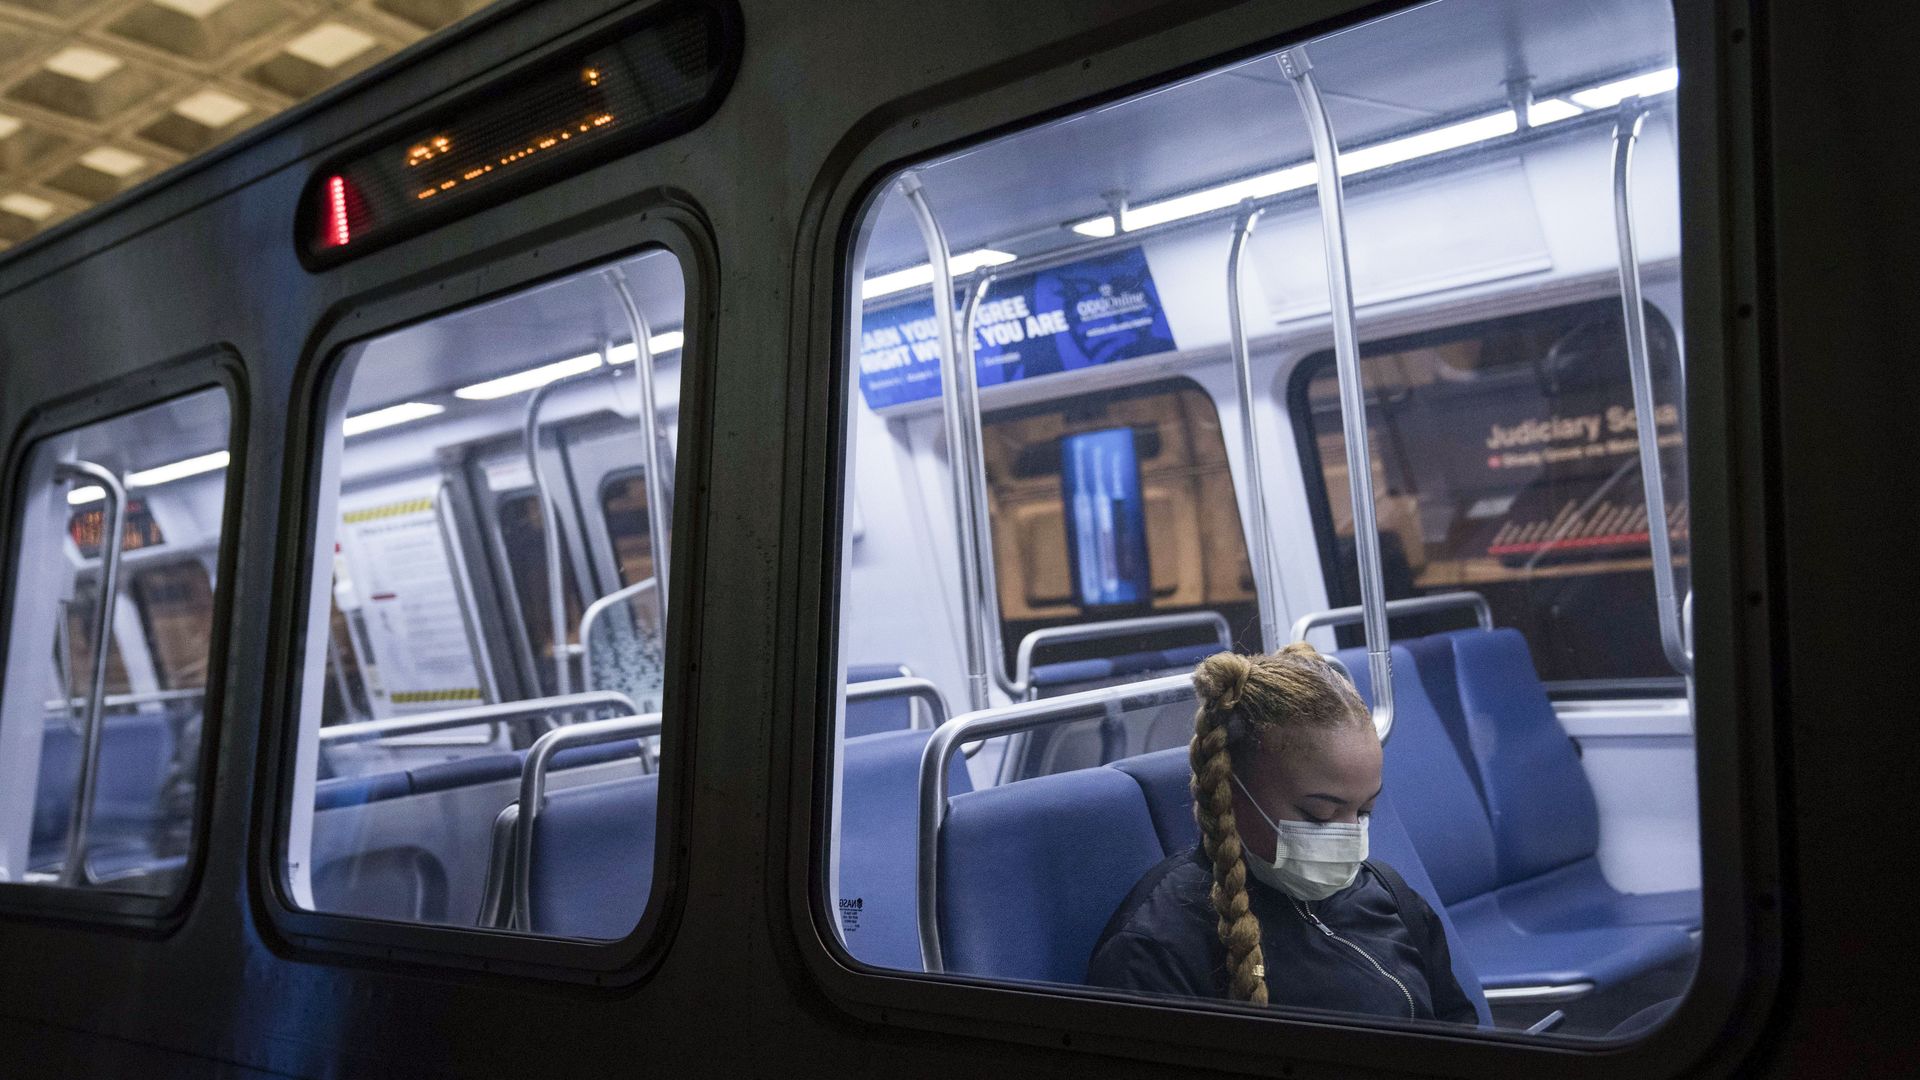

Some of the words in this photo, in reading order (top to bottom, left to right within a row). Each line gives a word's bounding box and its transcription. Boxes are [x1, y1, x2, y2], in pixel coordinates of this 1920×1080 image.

[861, 326, 902, 354] ARN
[899, 316, 940, 343] YOU
[979, 319, 1025, 348] YOU
[1025, 309, 1070, 339] ARE
[1487, 415, 1601, 449] Judiciary
